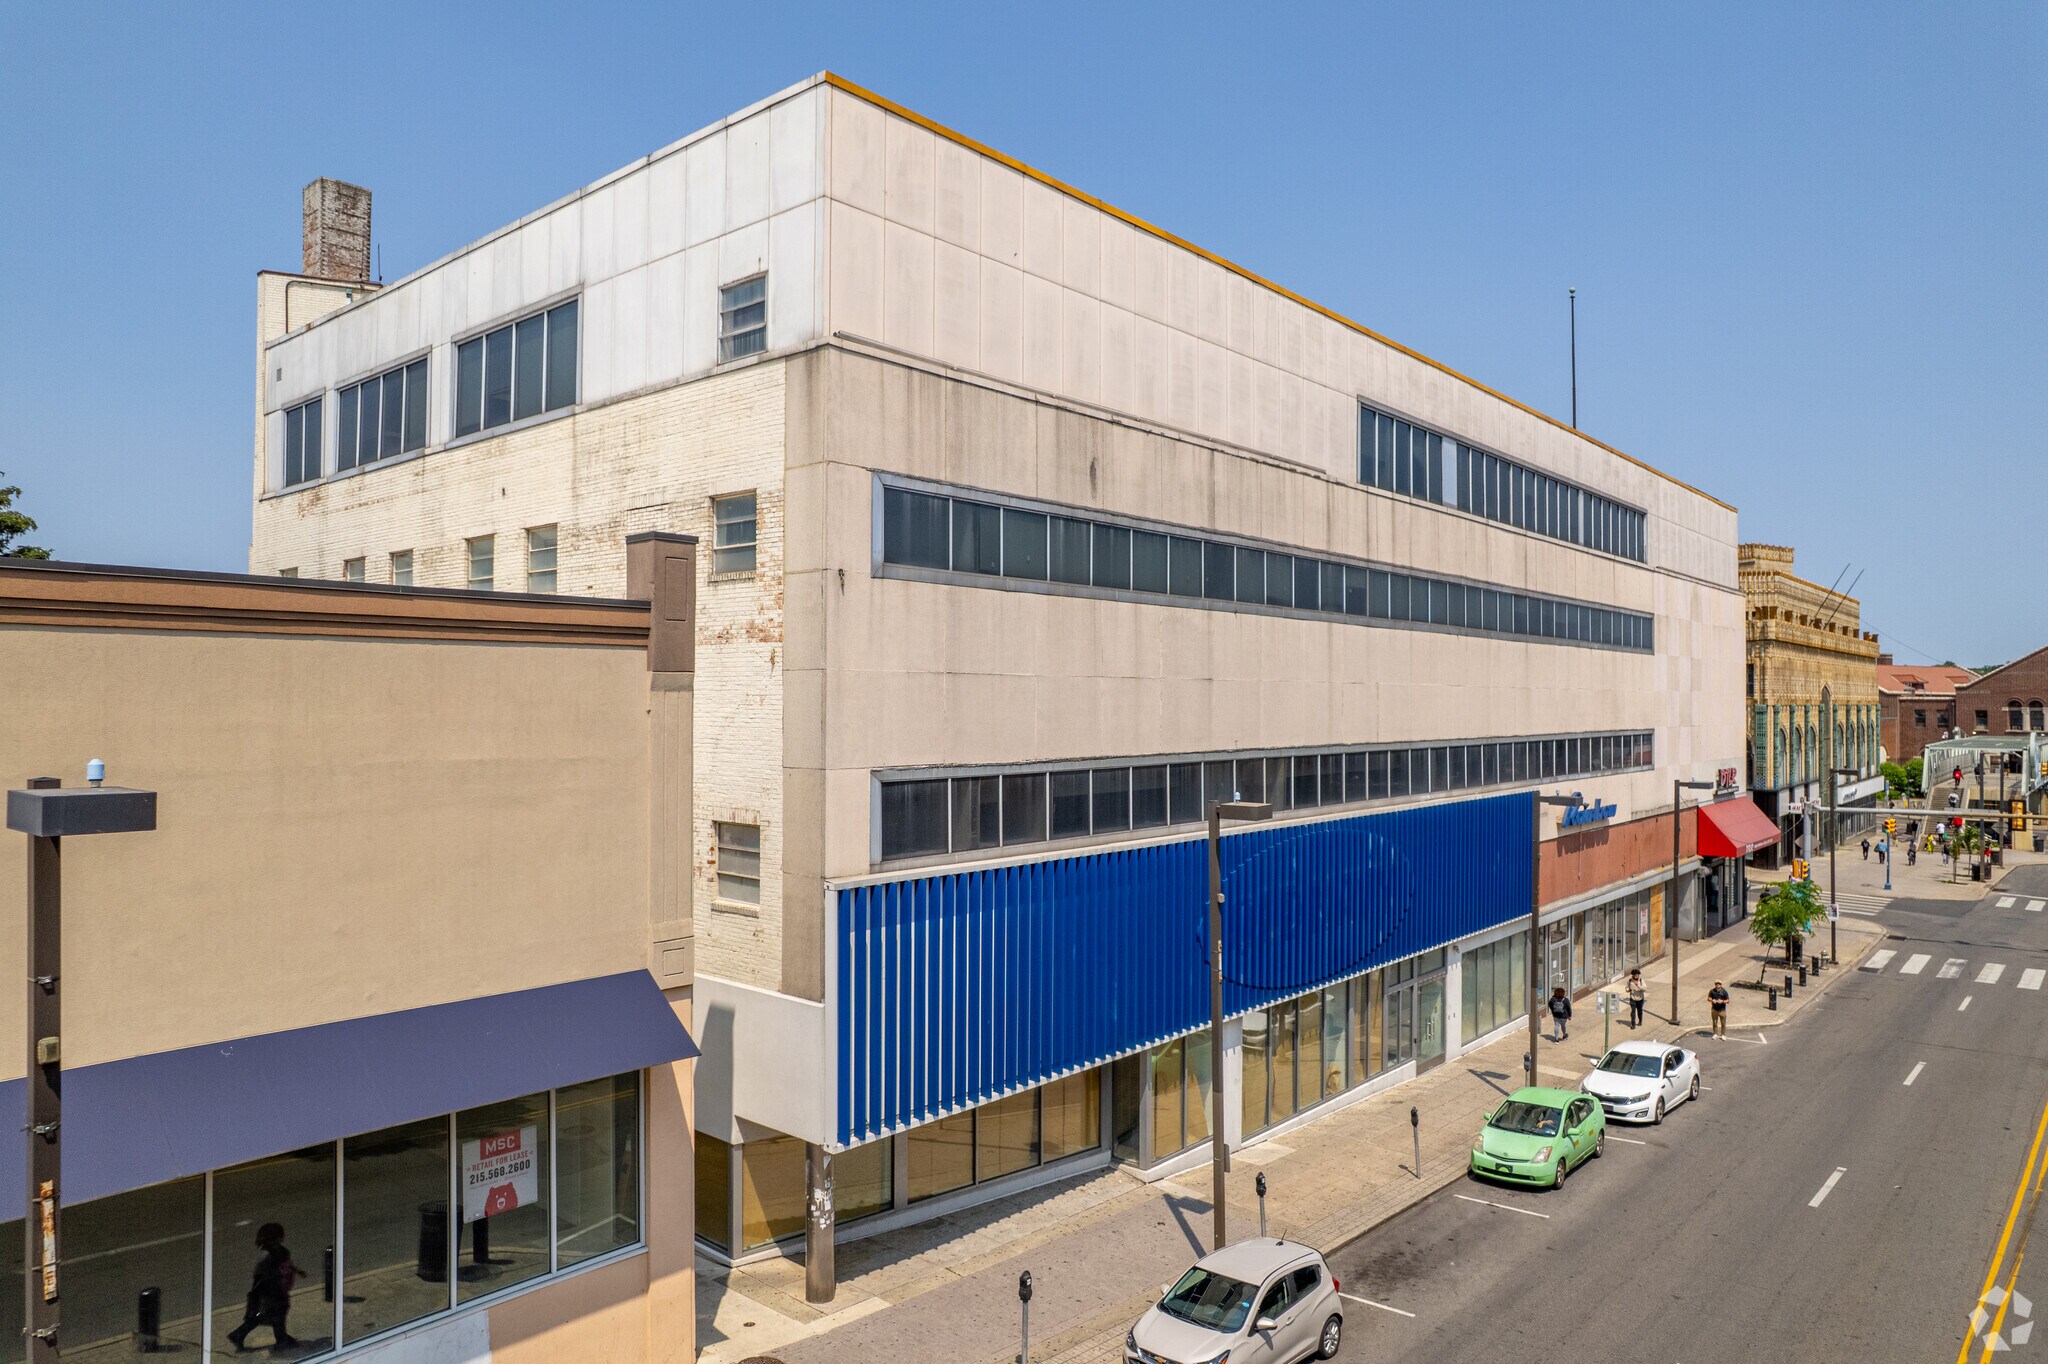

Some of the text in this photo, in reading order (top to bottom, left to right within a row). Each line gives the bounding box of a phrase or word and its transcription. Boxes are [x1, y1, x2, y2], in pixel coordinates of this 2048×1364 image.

[485, 1135, 515, 1155] MSC
[469, 1159, 531, 1185] 215.568.2600
[472, 1150, 529, 1172] RETAIL FOR LEASE
